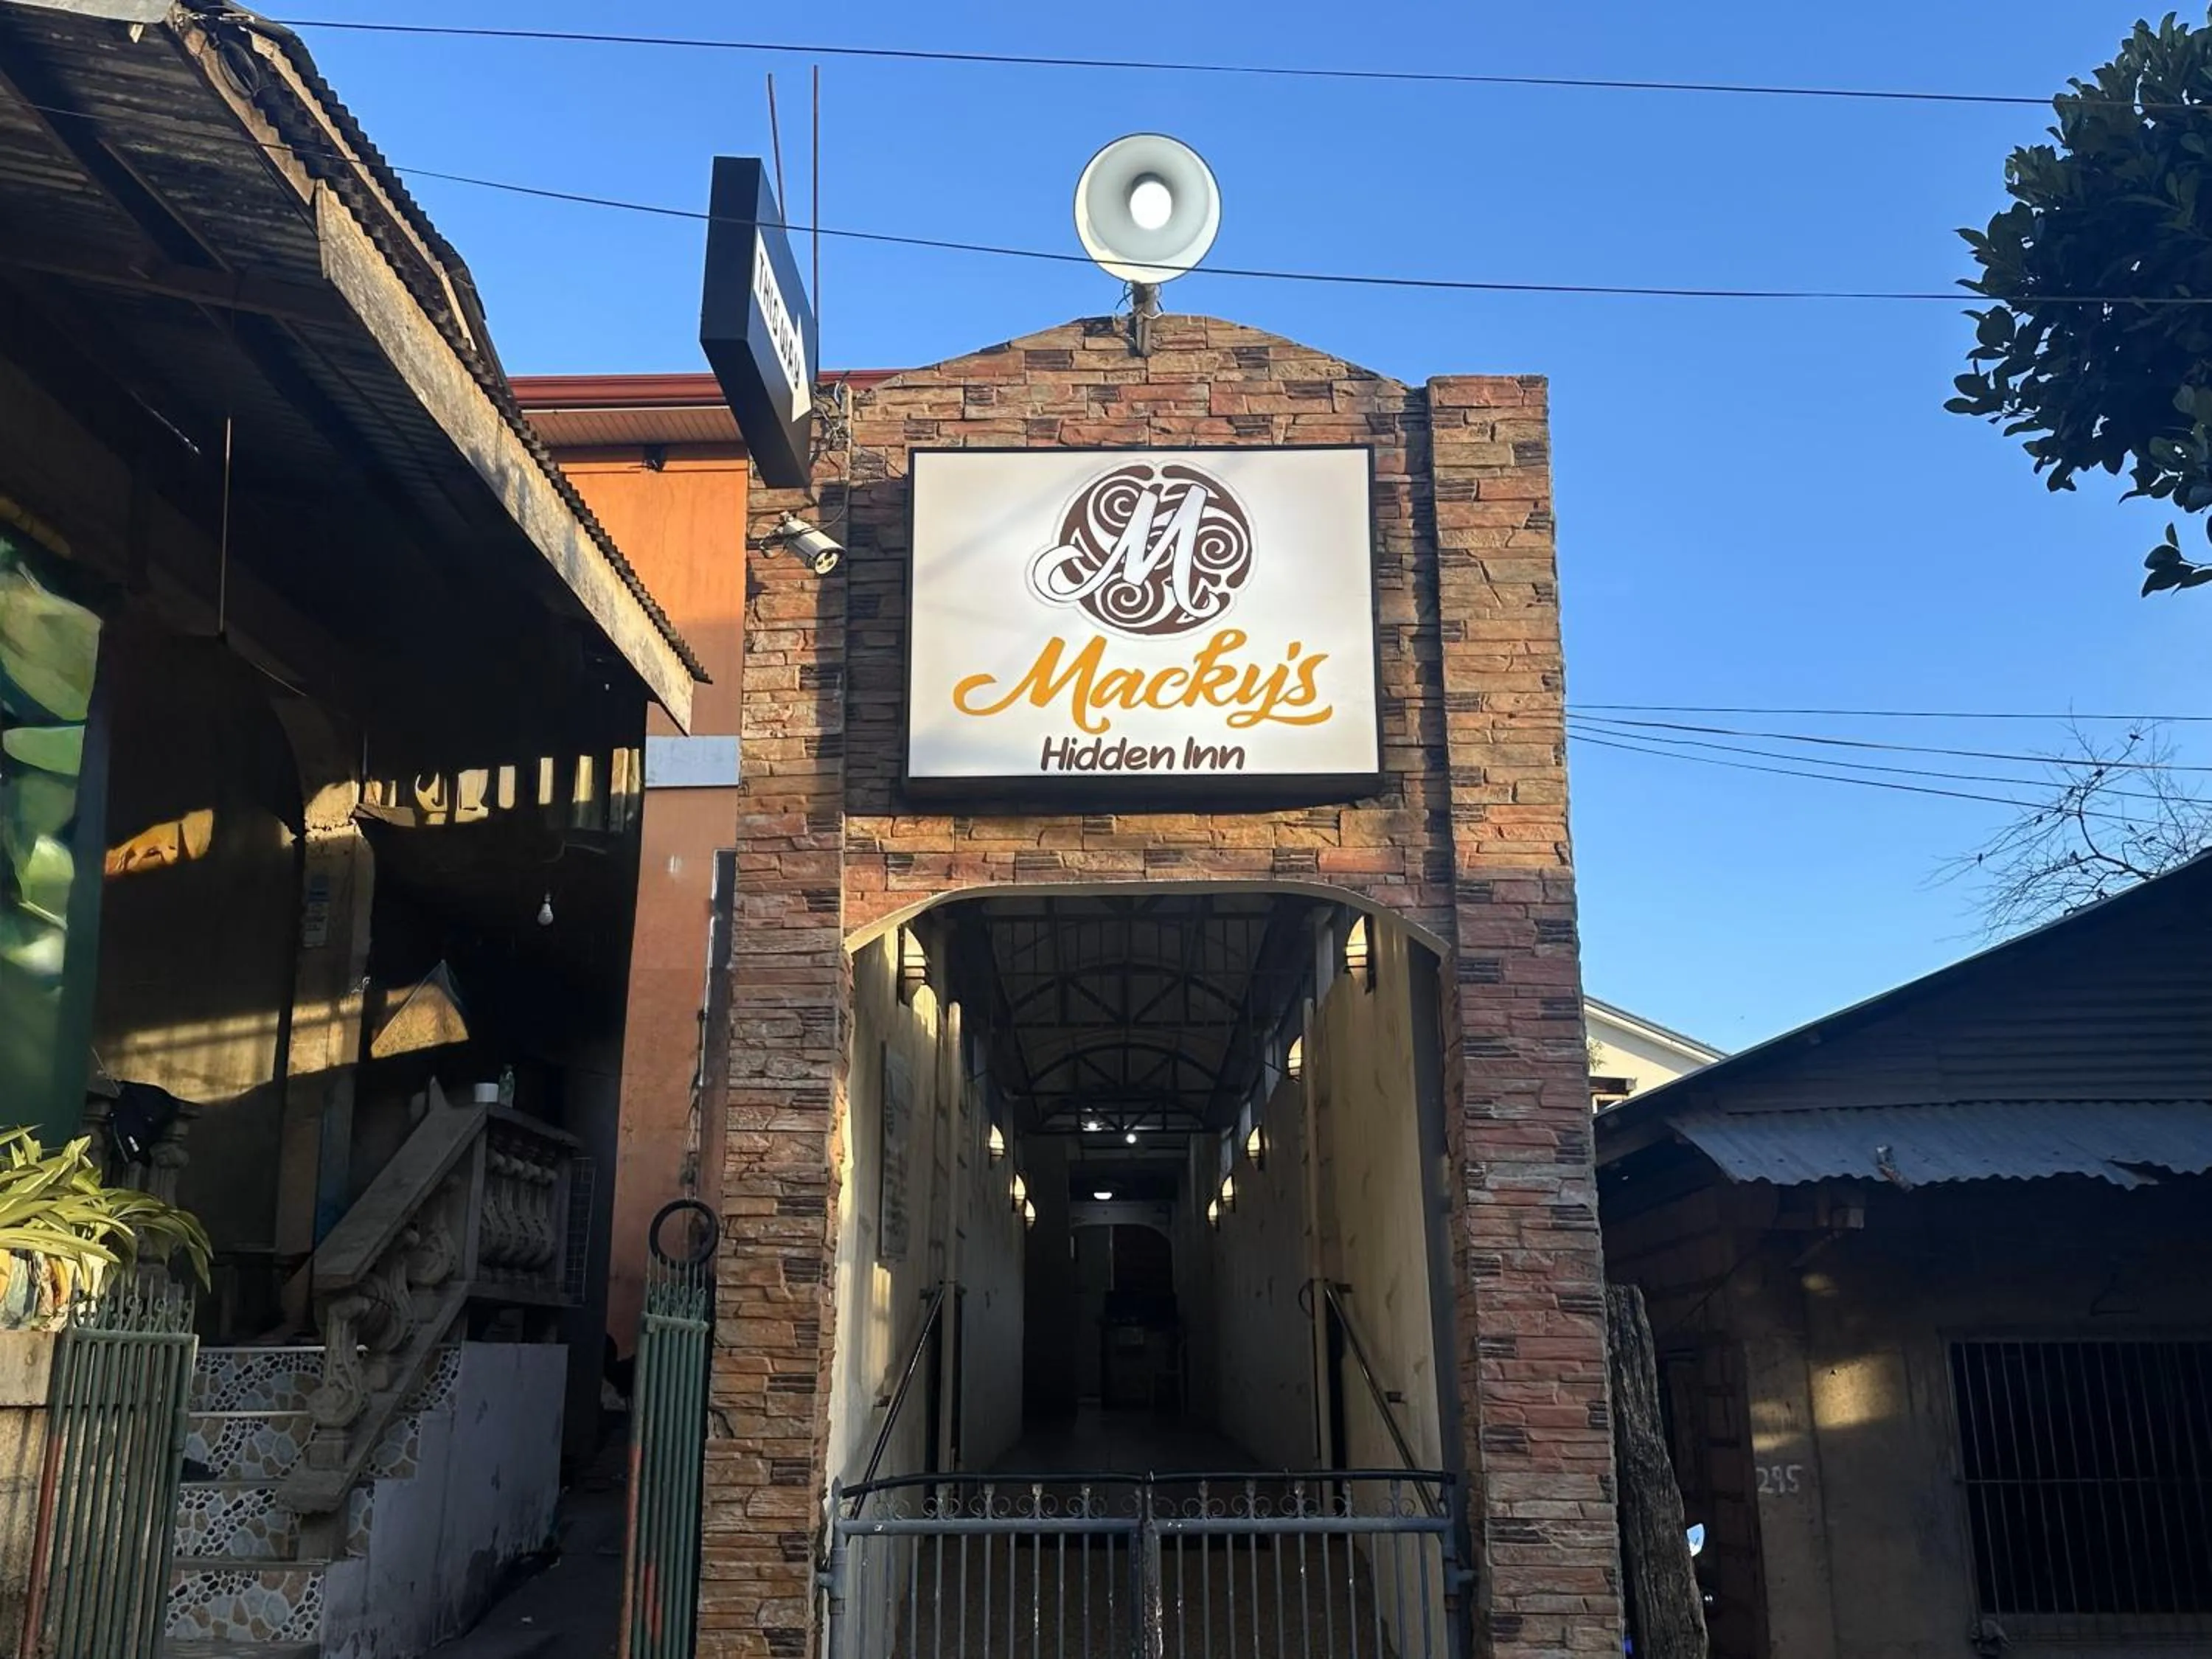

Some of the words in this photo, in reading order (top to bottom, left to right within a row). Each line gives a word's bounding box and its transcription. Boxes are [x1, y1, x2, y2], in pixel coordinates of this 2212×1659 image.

[758, 251, 779, 336] THIS
[779, 316, 801, 389] WAY
[1032, 484, 1220, 618] M
[952, 629, 1333, 734] Macky's
[1040, 736, 1175, 771] Hidden
[1183, 736, 1245, 771] Inn
[1755, 1464, 1803, 1494] 295
